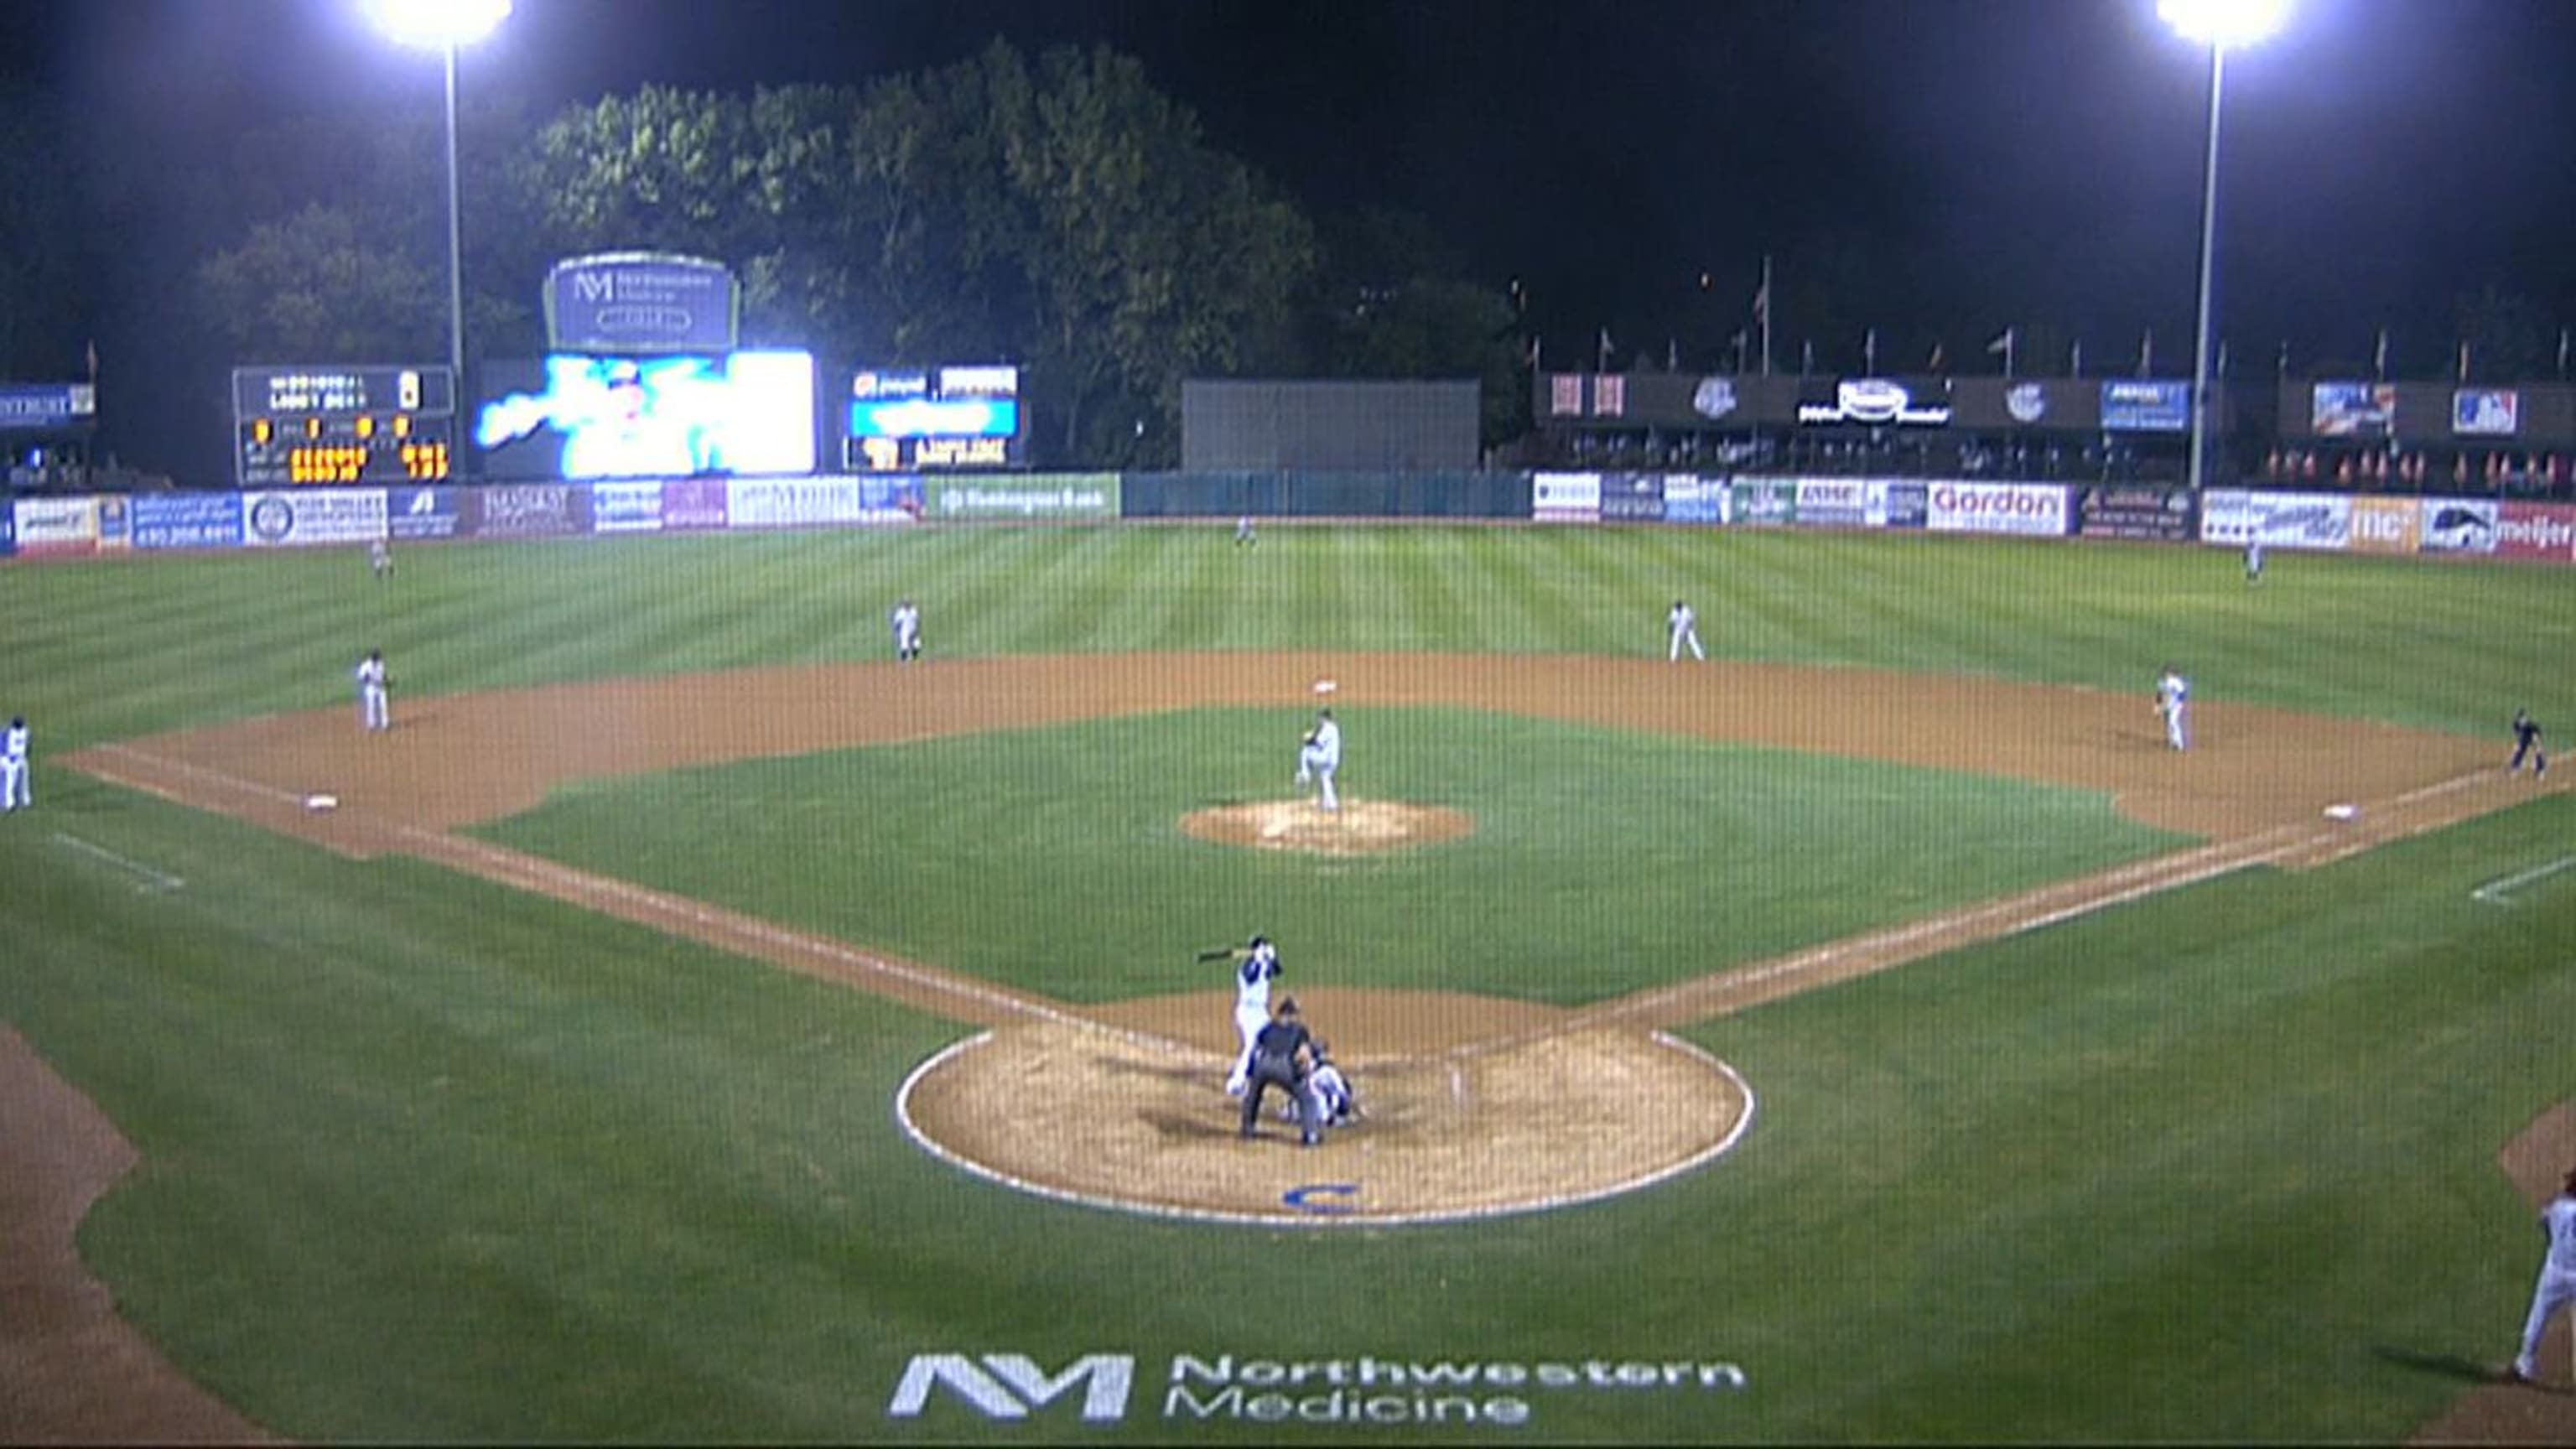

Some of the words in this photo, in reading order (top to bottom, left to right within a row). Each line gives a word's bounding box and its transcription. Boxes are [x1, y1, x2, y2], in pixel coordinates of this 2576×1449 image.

[1933, 486, 2059, 516] Gordon
[2497, 515, 2571, 549] meijer
[1171, 1353, 1747, 1387] Northwestern
[1163, 1384, 1533, 1424] Medicine
